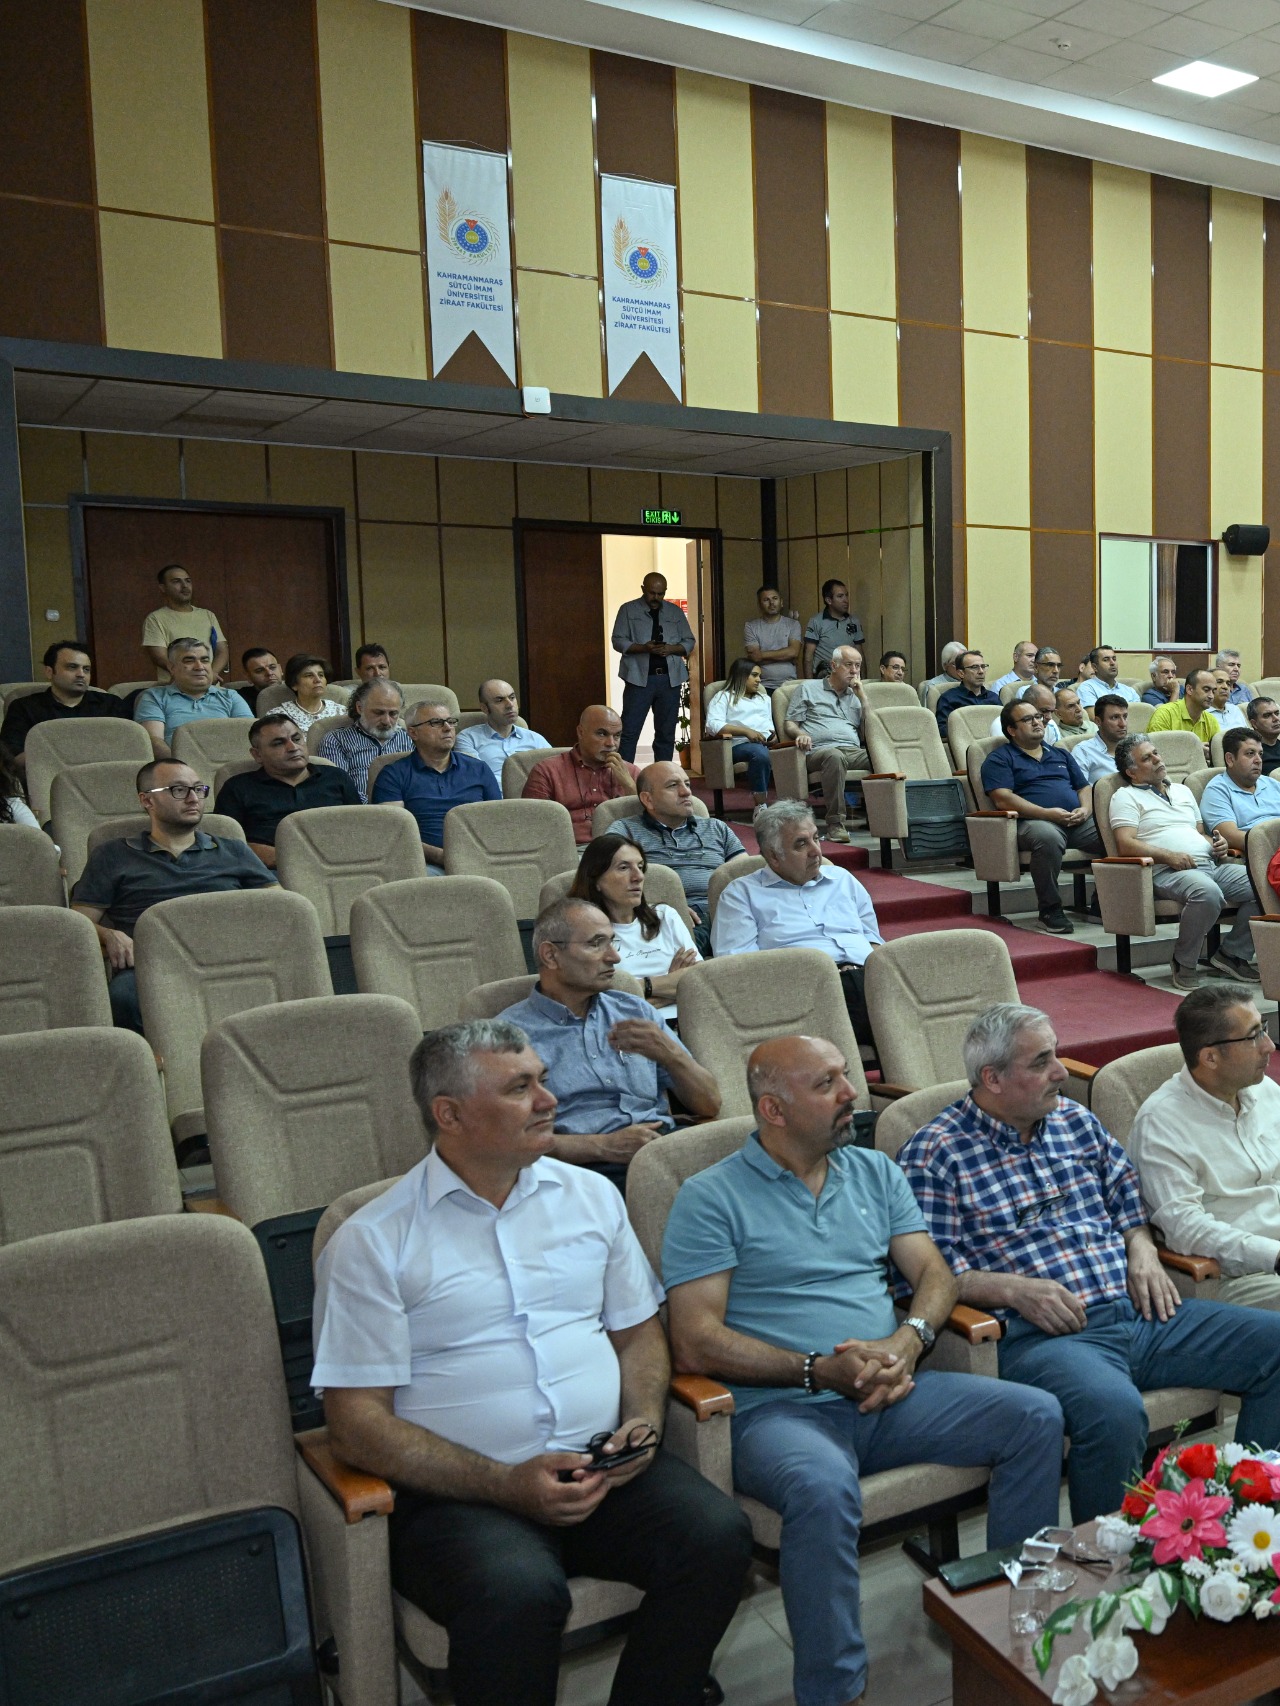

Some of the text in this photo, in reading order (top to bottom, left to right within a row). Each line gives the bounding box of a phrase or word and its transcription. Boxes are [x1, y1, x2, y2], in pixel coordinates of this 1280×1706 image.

[437, 271, 503, 286] KAHRAMANMARAŞ
[448, 281, 493, 293] SÜTÇÜ İMAM
[447, 289, 495, 302] ÜNİVERSİTESİ
[439, 298, 504, 311] ZİRAAT FAKÜLTESİ
[612, 296, 671, 310] KAHRAMANMARAŞ
[622, 305, 662, 316] SÜTÇÜ İMAM
[620, 312, 664, 325] ÜNİVERSİTESİ
[614, 321, 671, 334] ZİRAAT FAKÜLTESİ
